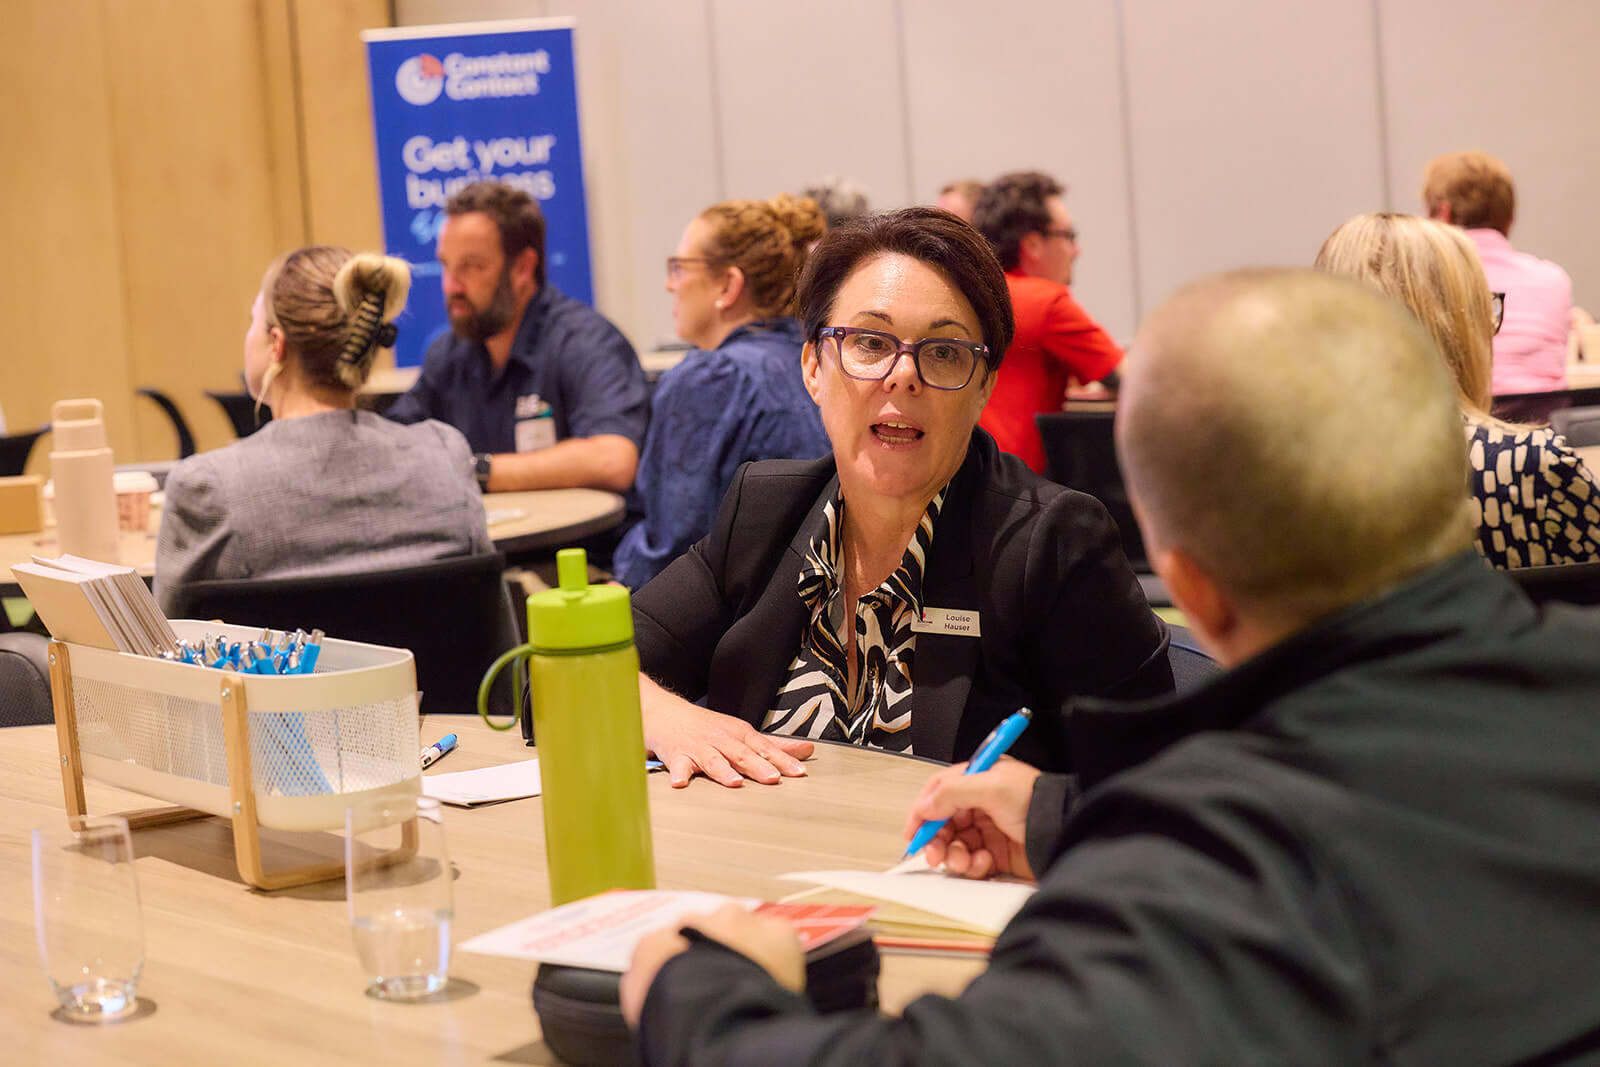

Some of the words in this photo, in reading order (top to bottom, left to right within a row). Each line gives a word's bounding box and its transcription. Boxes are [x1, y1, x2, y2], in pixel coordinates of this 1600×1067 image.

[443, 50, 550, 78] Constant
[445, 73, 539, 100] Contact
[402, 135, 472, 174] Get
[472, 134, 556, 176] your
[943, 623, 971, 632] Hauser
[945, 614, 971, 623] Louise
